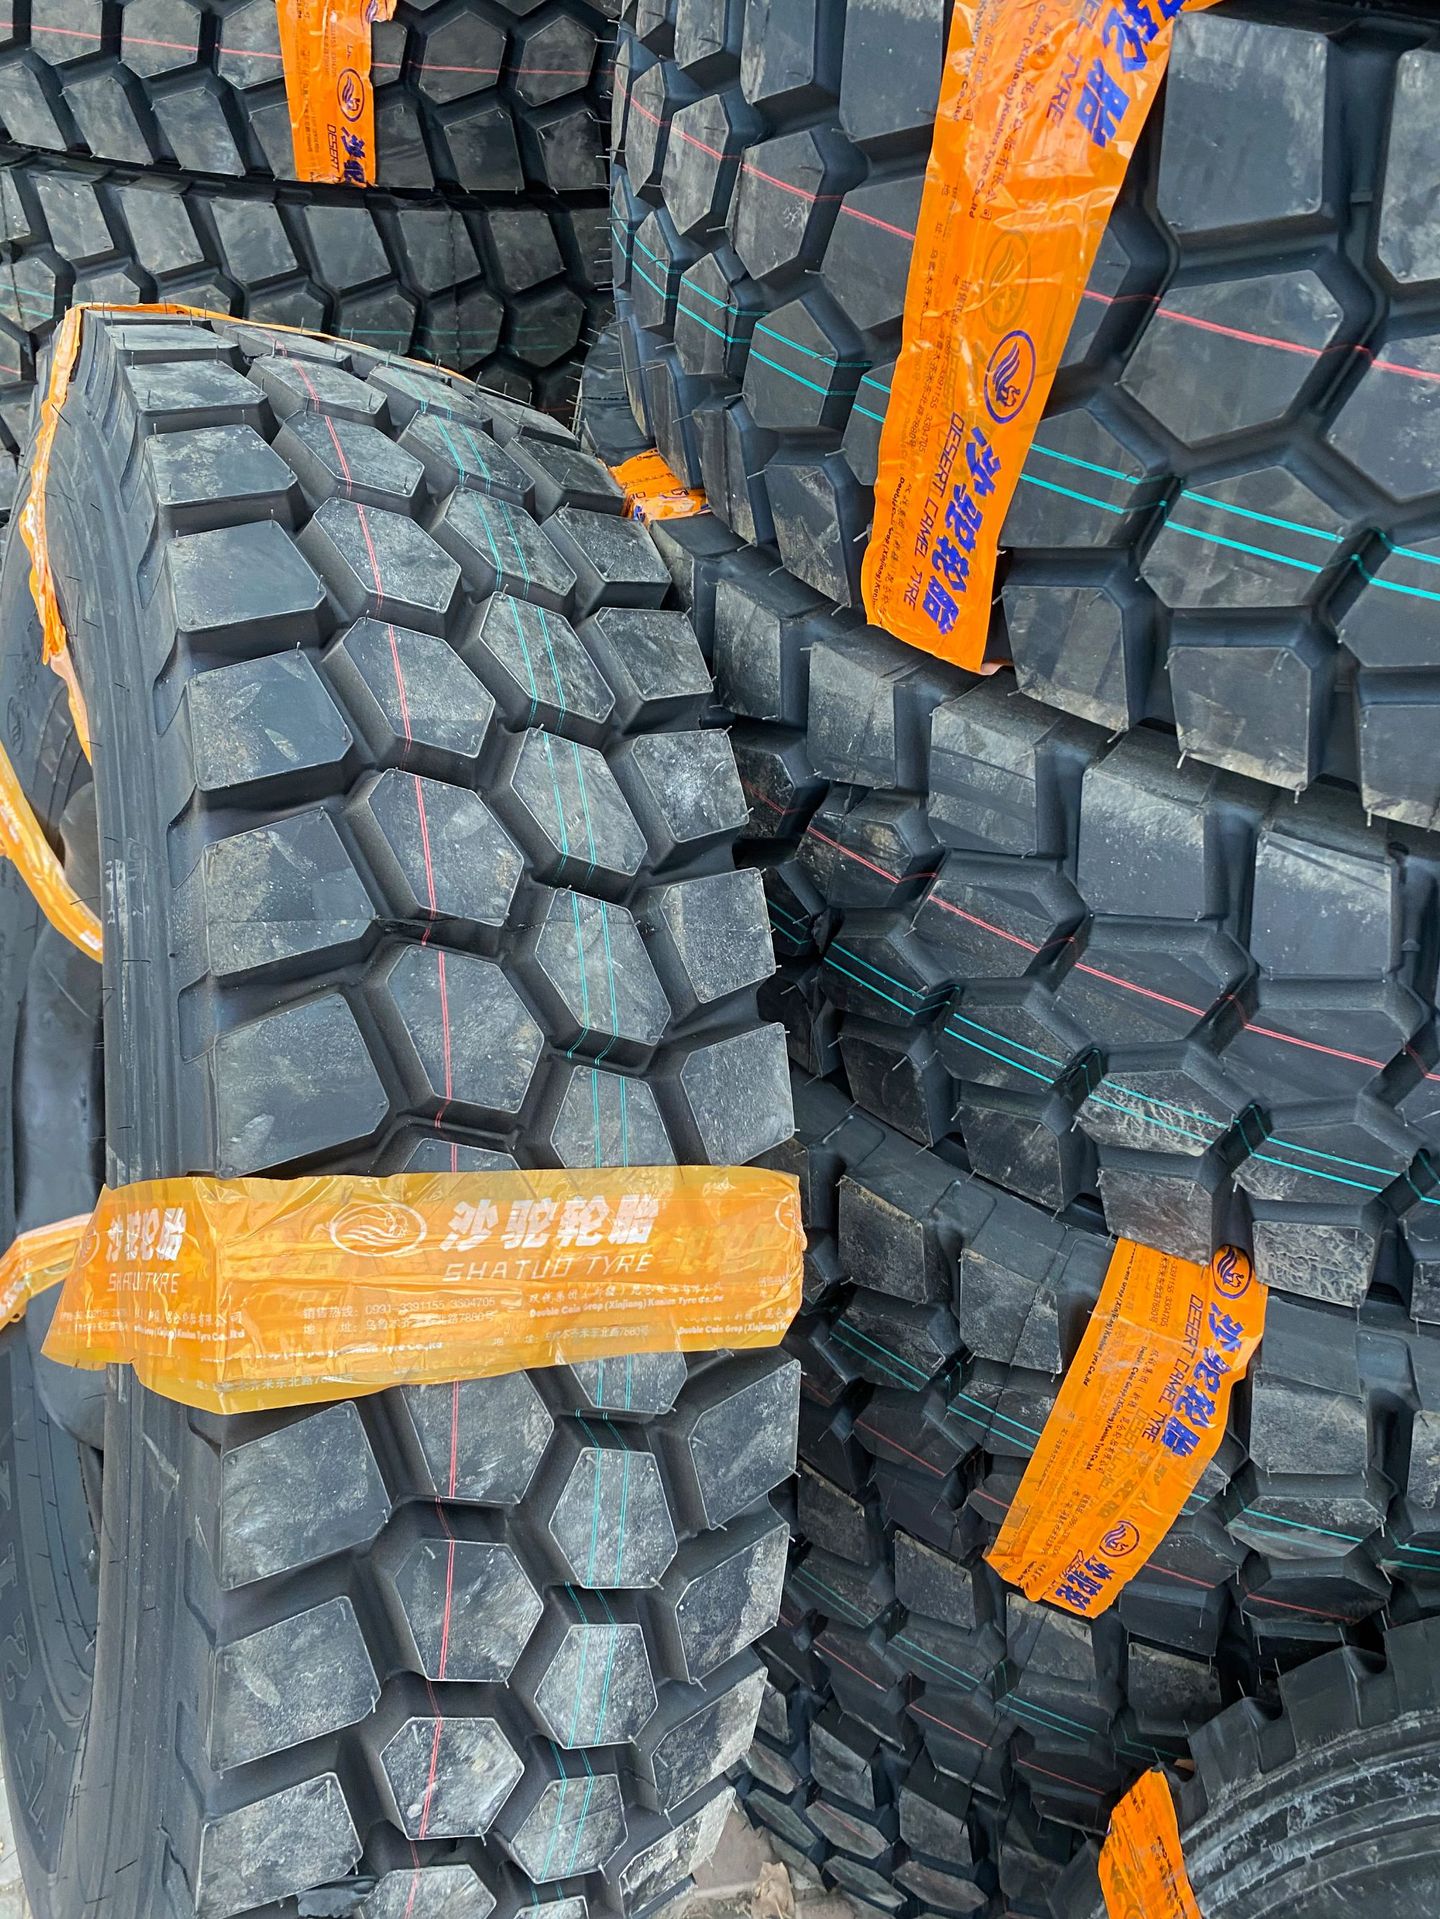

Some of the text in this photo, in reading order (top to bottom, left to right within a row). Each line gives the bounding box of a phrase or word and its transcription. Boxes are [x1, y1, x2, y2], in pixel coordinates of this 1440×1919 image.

[1046, 52, 1083, 128] TYRE
[327, 124, 340, 173] DESERT
[903, 411, 966, 611] DESERT CAMEL TYRE
[921, 426, 1002, 635] 沙驼轮胎
[439, 1194, 660, 1252] 沙驼轮胎
[442, 1253, 654, 1283] SHATUO TYRE
[1142, 1293, 1206, 1444] DESERT CAMEL TYRE
[1160, 1301, 1245, 1457] 沙驼轮胎
